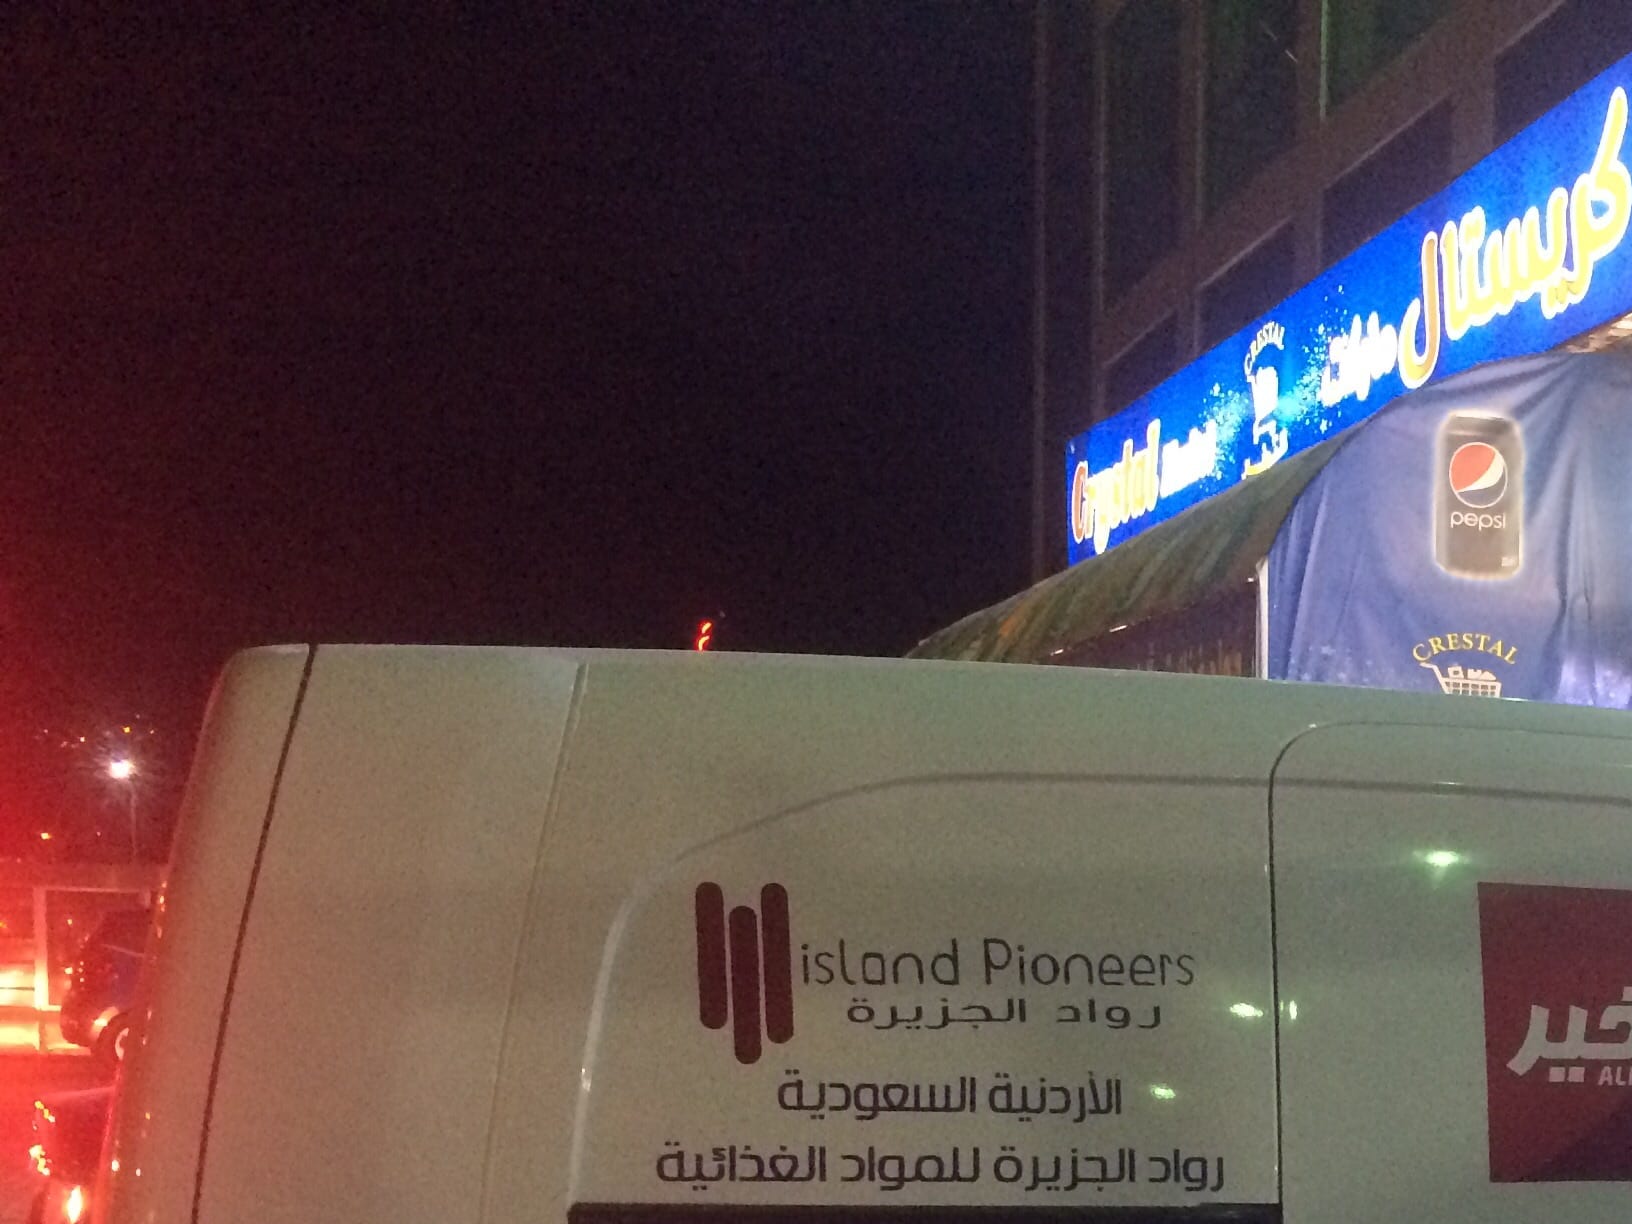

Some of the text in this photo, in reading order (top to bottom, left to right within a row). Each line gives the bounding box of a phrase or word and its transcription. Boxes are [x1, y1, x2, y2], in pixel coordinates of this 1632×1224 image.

[1398, 86, 1632, 390] كريستال
[1244, 321, 1286, 376] CRESTAL
[1072, 418, 1160, 554] Crystal
[1450, 511, 1507, 532] pepsi
[1412, 632, 1518, 665] CRESTAL
[983, 938, 1196, 987] Pioneers
[846, 997, 1162, 1030] رواد الجزيرة
[777, 1069, 977, 1121] السعودية
[656, 1141, 1225, 1192] رواد الجزيرة للمواد الغذائية
